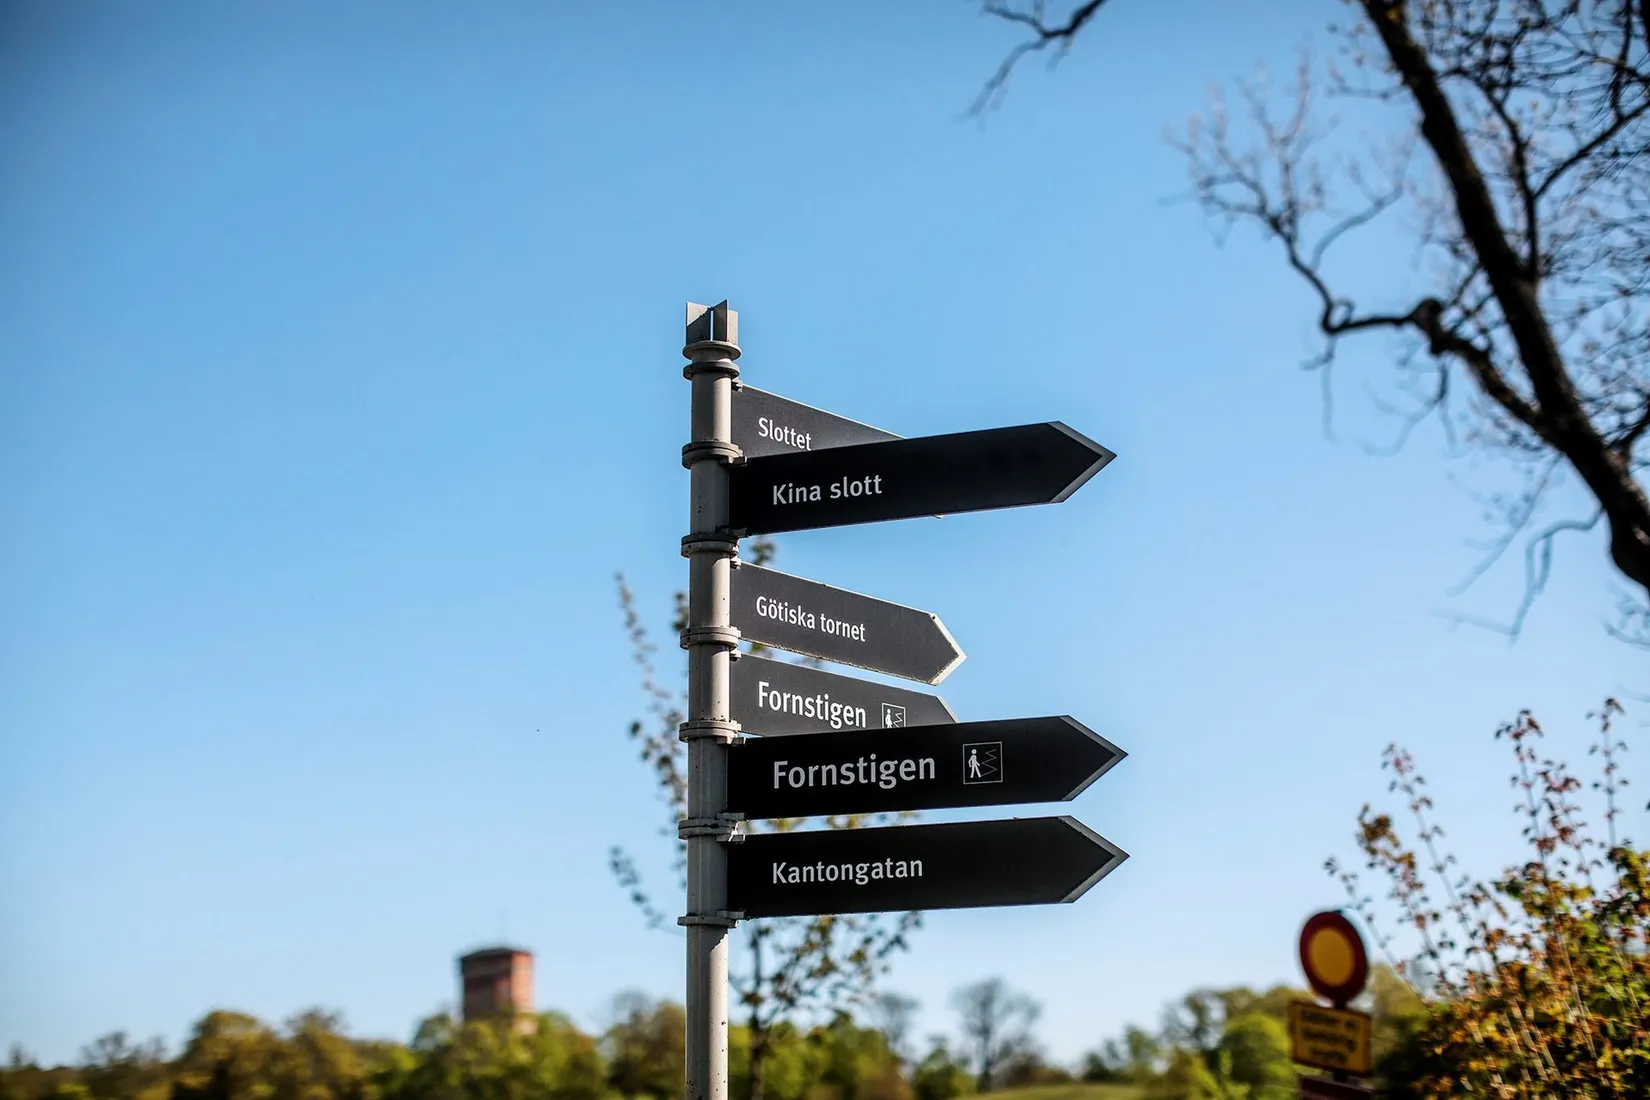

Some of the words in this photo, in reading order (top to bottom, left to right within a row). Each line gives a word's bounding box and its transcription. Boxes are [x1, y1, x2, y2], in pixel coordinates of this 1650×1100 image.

[757, 416, 812, 452] Slottet
[773, 483, 822, 506] Kina
[829, 474, 883, 499] slott
[755, 595, 816, 630] Götiska
[819, 612, 866, 643] tornet
[758, 680, 867, 729] Fornstigen
[773, 753, 936, 790] Fornstigen
[772, 857, 923, 886] Kantongatan
